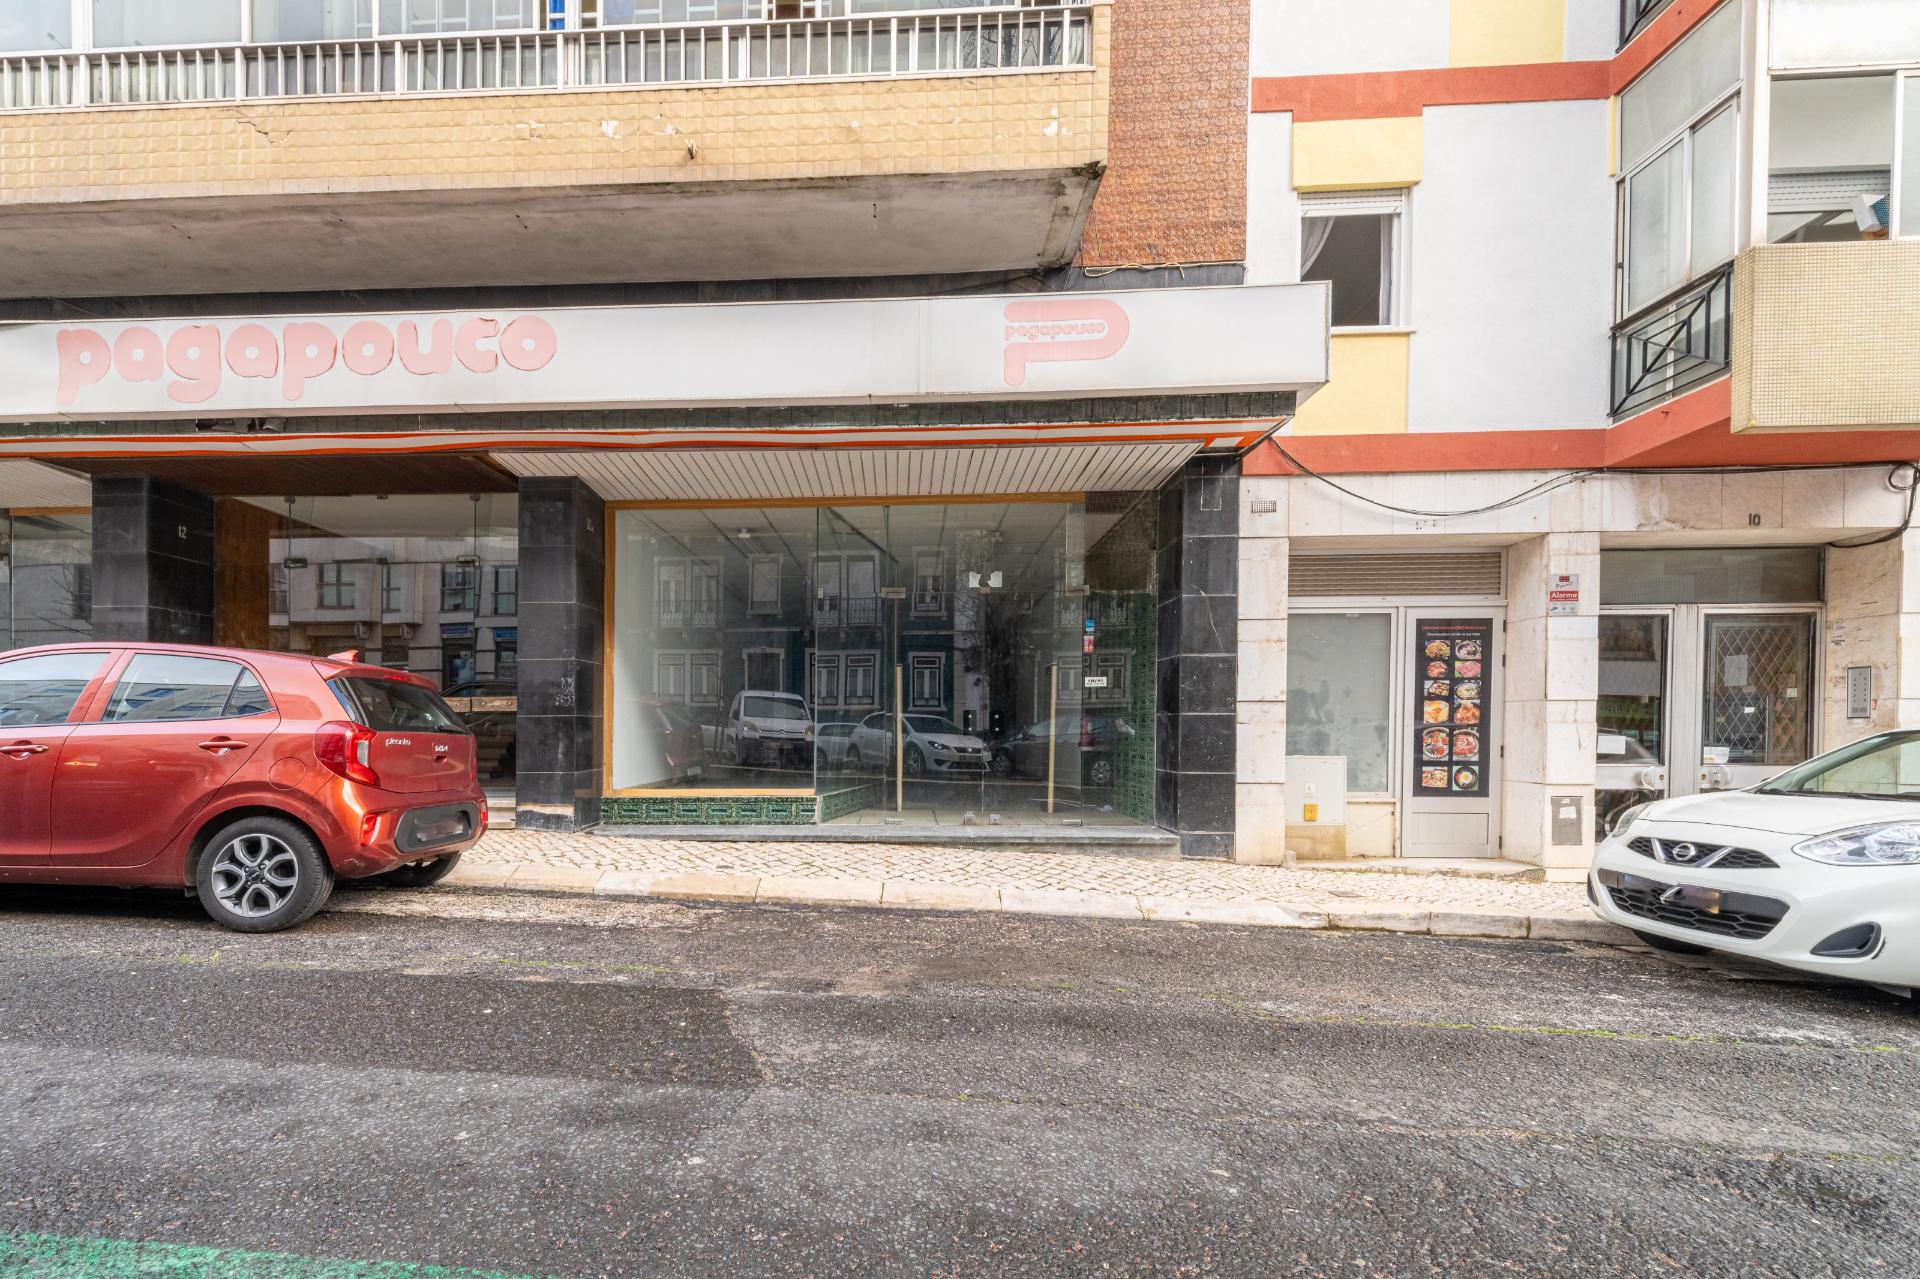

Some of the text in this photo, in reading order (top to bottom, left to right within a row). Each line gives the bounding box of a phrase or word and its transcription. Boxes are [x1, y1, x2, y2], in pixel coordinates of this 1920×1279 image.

[1004, 322, 1106, 341] pagapouco
[56, 315, 557, 406] pagapouco
[1748, 513, 1761, 526] 10
[178, 525, 187, 539] 12
